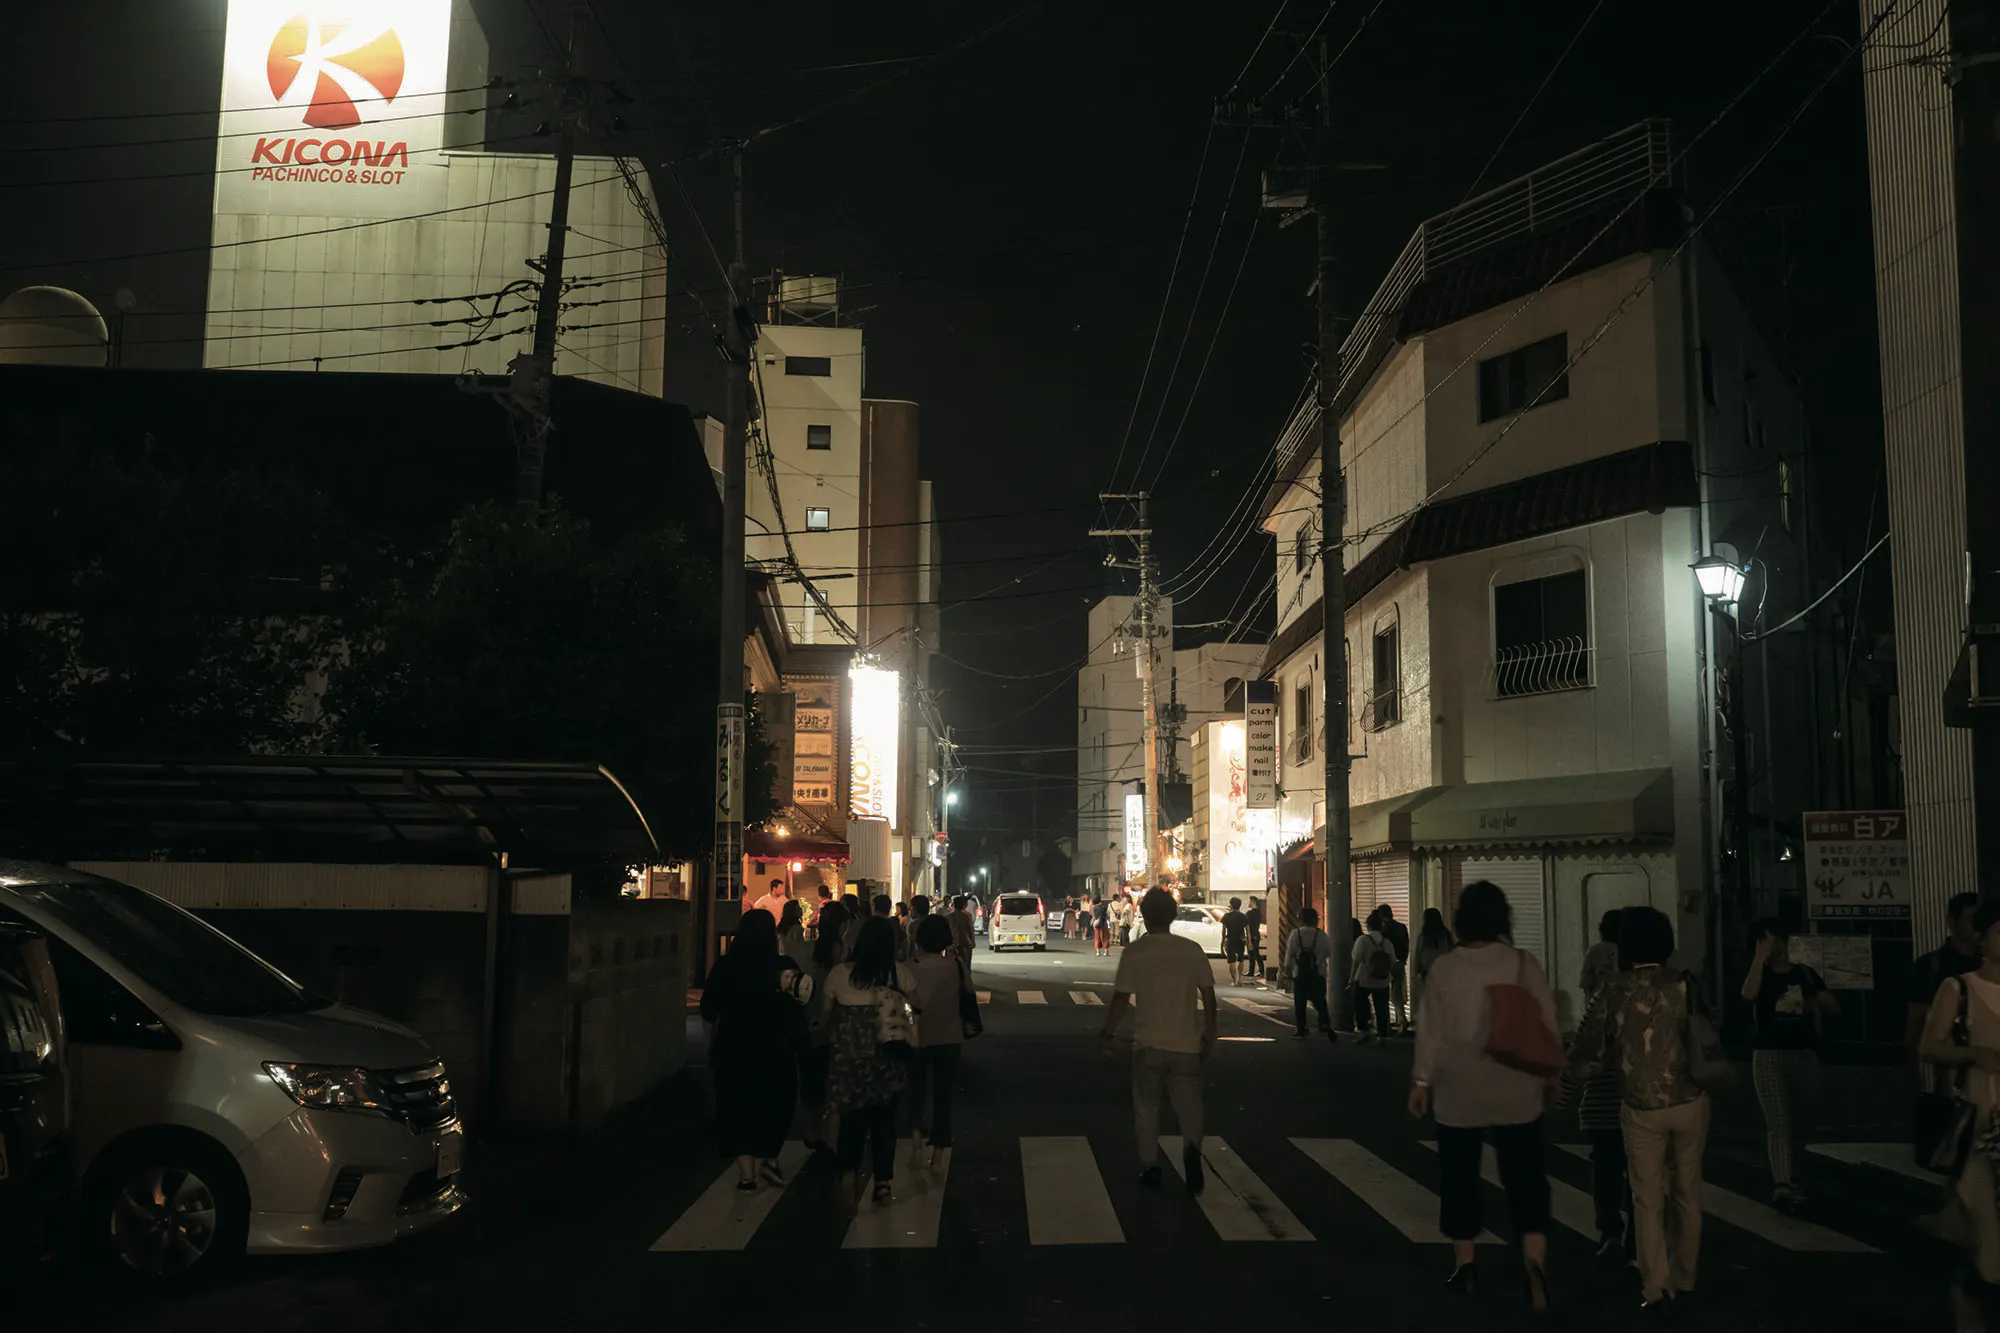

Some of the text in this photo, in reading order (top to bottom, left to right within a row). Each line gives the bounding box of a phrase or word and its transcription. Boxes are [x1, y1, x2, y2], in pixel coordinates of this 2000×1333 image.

[251, 137, 408, 168] KICONA
[252, 167, 405, 185] PACHINCO & SLOT
[1251, 731, 1271, 739] color
[1249, 744, 1273, 752] make
[1256, 792, 1268, 801] 2F
[1861, 881, 1894, 899] JA
